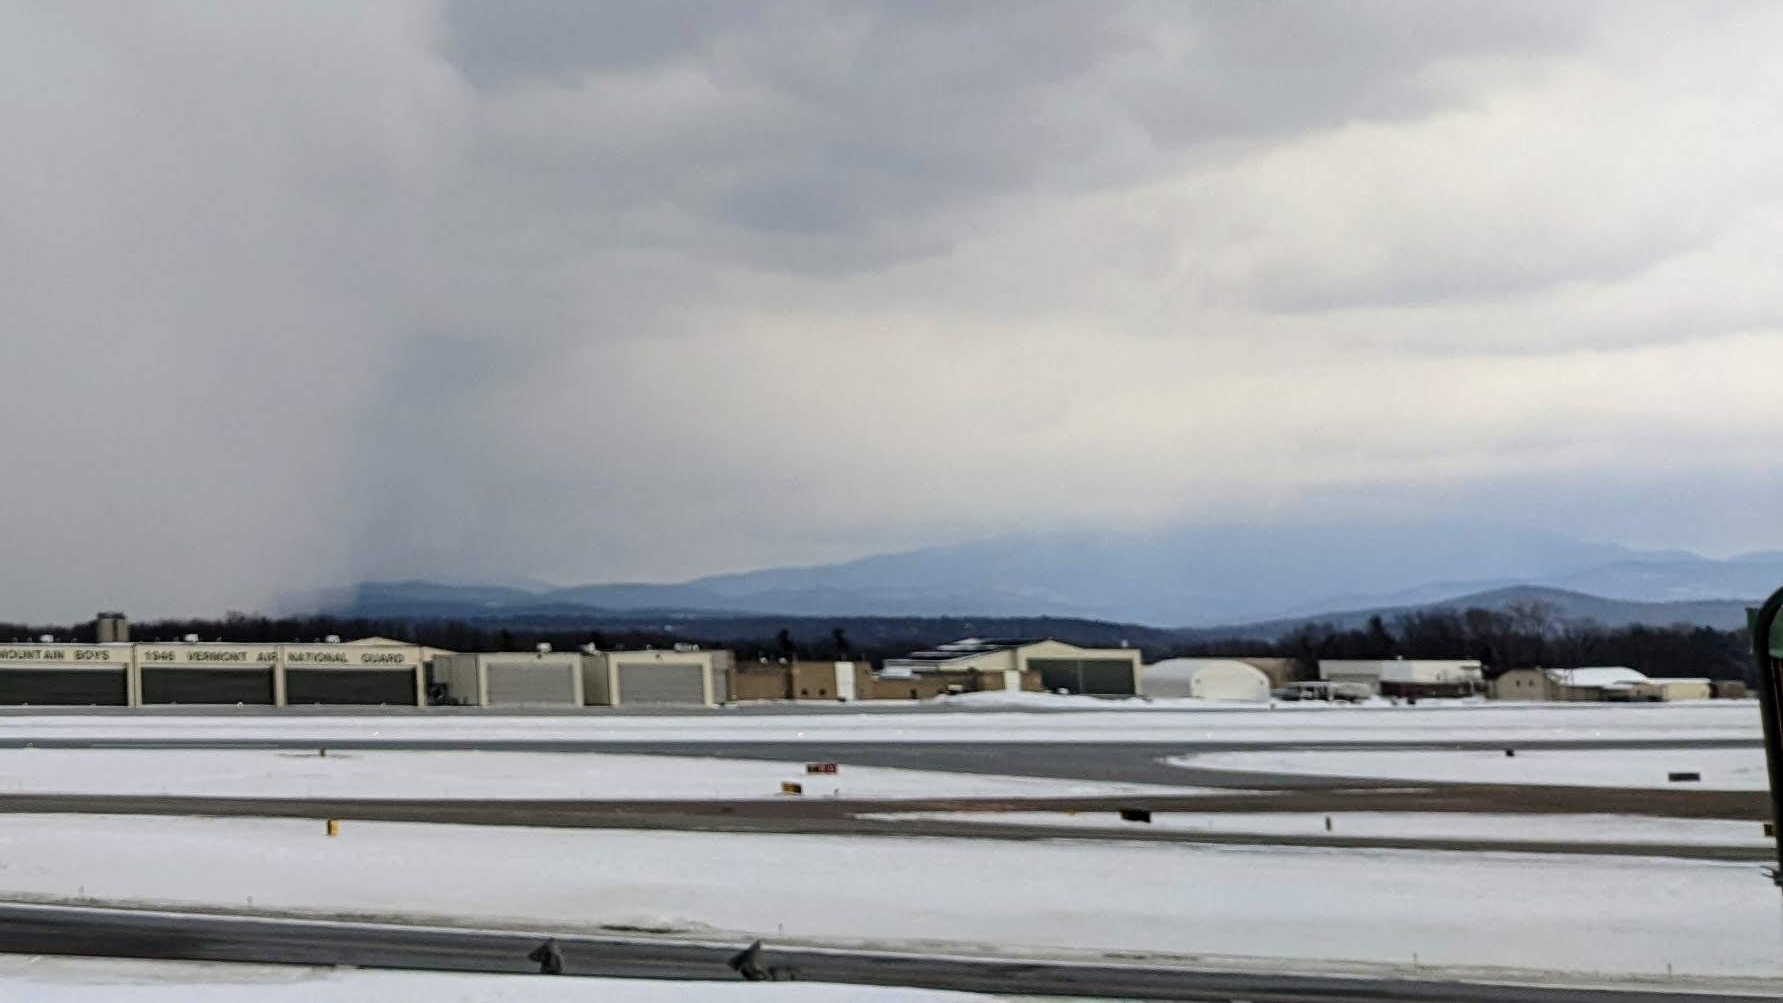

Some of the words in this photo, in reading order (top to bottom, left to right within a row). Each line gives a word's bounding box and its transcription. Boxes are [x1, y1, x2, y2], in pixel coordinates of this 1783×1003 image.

[73, 649, 111, 661] BOYS
[186, 651, 248, 662] VERMONT
[256, 651, 278, 662] AIR
[287, 651, 348, 663] NATIONAL
[360, 652, 405, 664] GUARD
